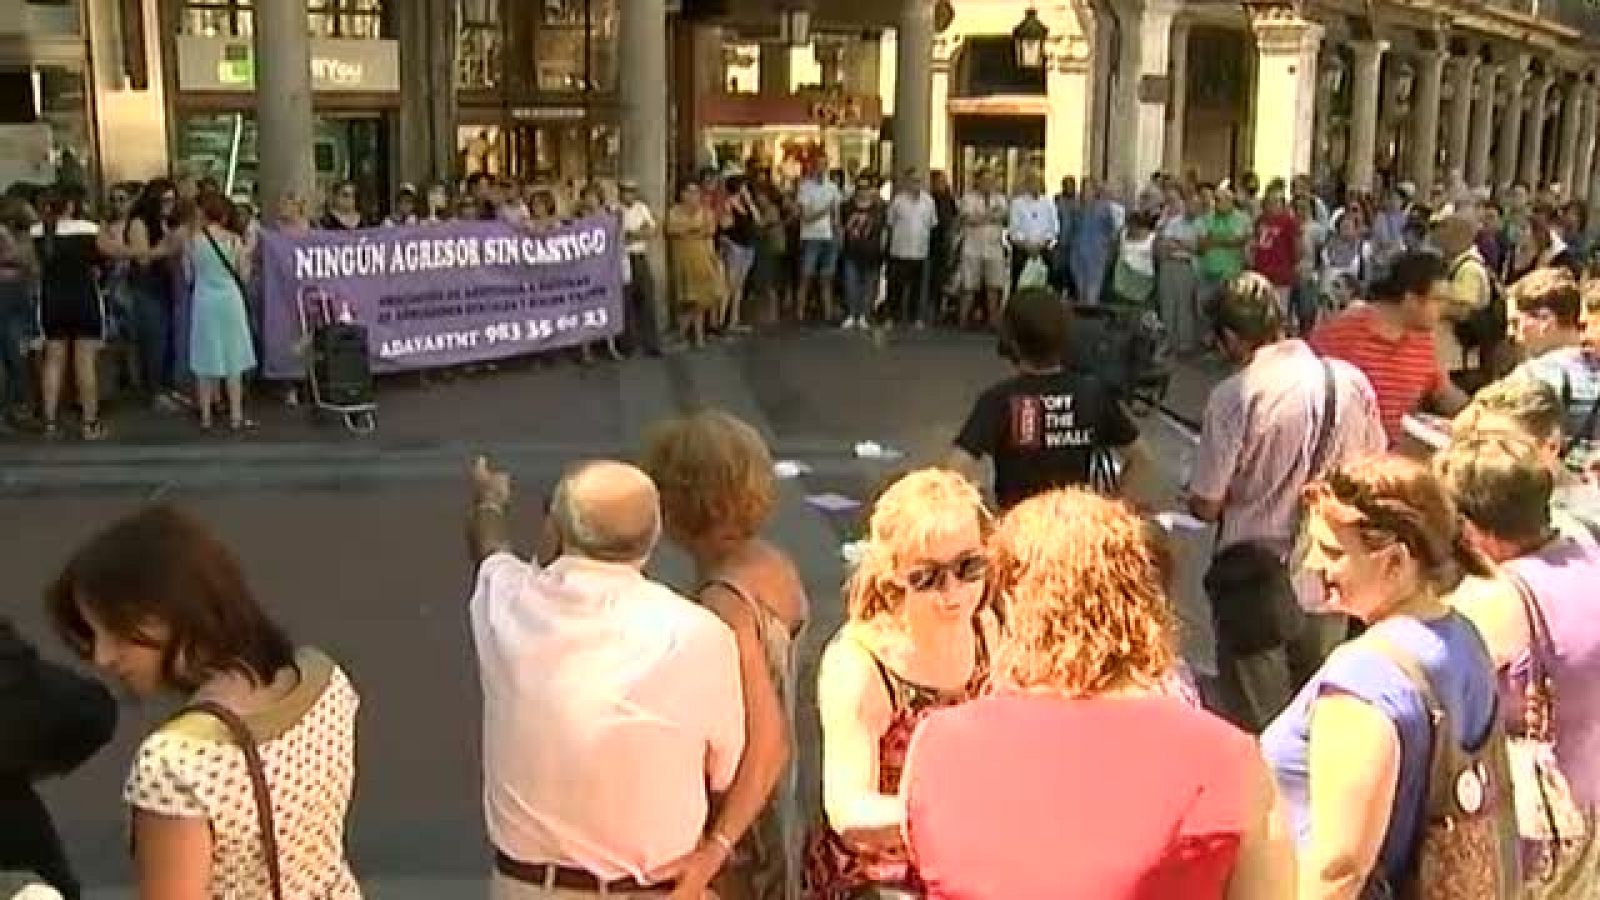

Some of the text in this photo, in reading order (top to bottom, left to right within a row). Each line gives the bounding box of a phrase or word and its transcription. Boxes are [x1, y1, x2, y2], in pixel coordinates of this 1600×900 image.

[295, 229, 606, 280] NINGÚN AGRESOR SIN CASTIGO
[1045, 411, 1075, 429] THE
